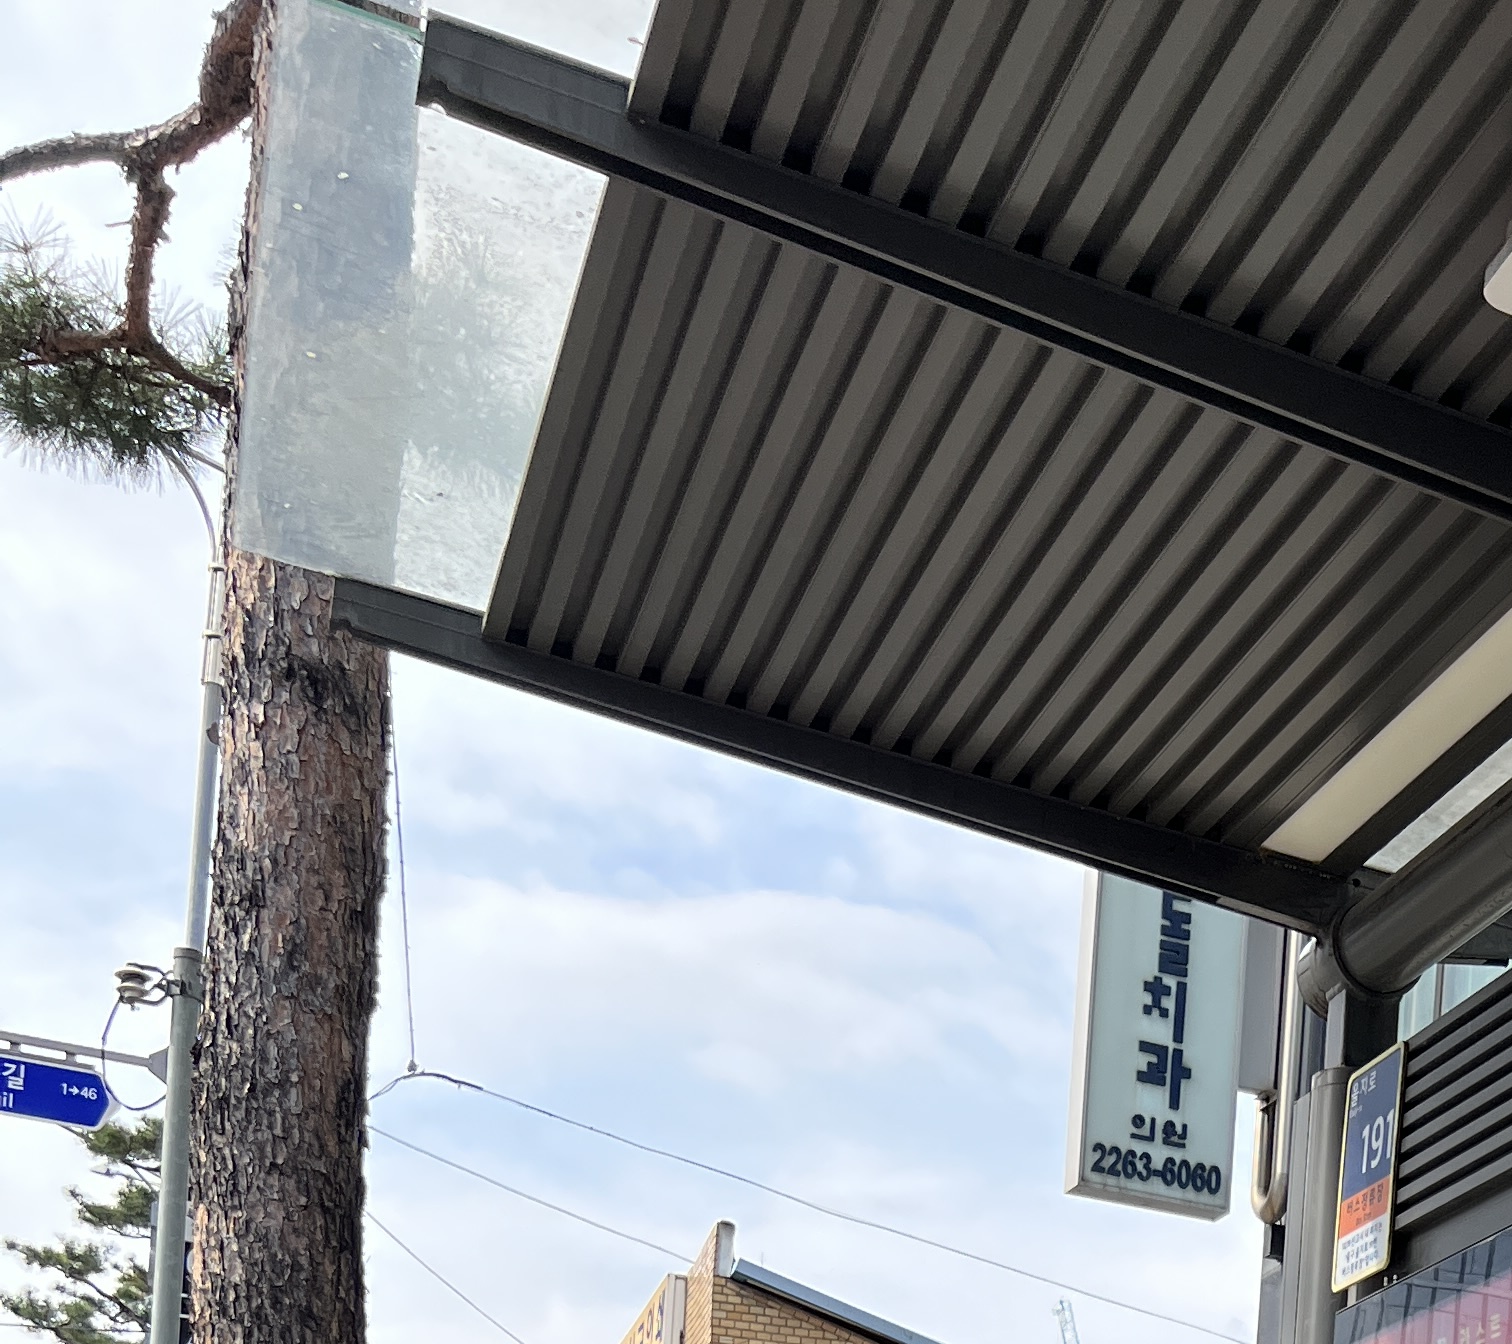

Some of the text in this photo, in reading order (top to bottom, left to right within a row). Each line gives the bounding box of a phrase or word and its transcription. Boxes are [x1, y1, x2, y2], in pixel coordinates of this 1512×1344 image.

[1130, 1113, 1188, 1149] 의원
[1361, 1108, 1395, 1174] 191
[1090, 1142, 1222, 1196] 2263-6060
